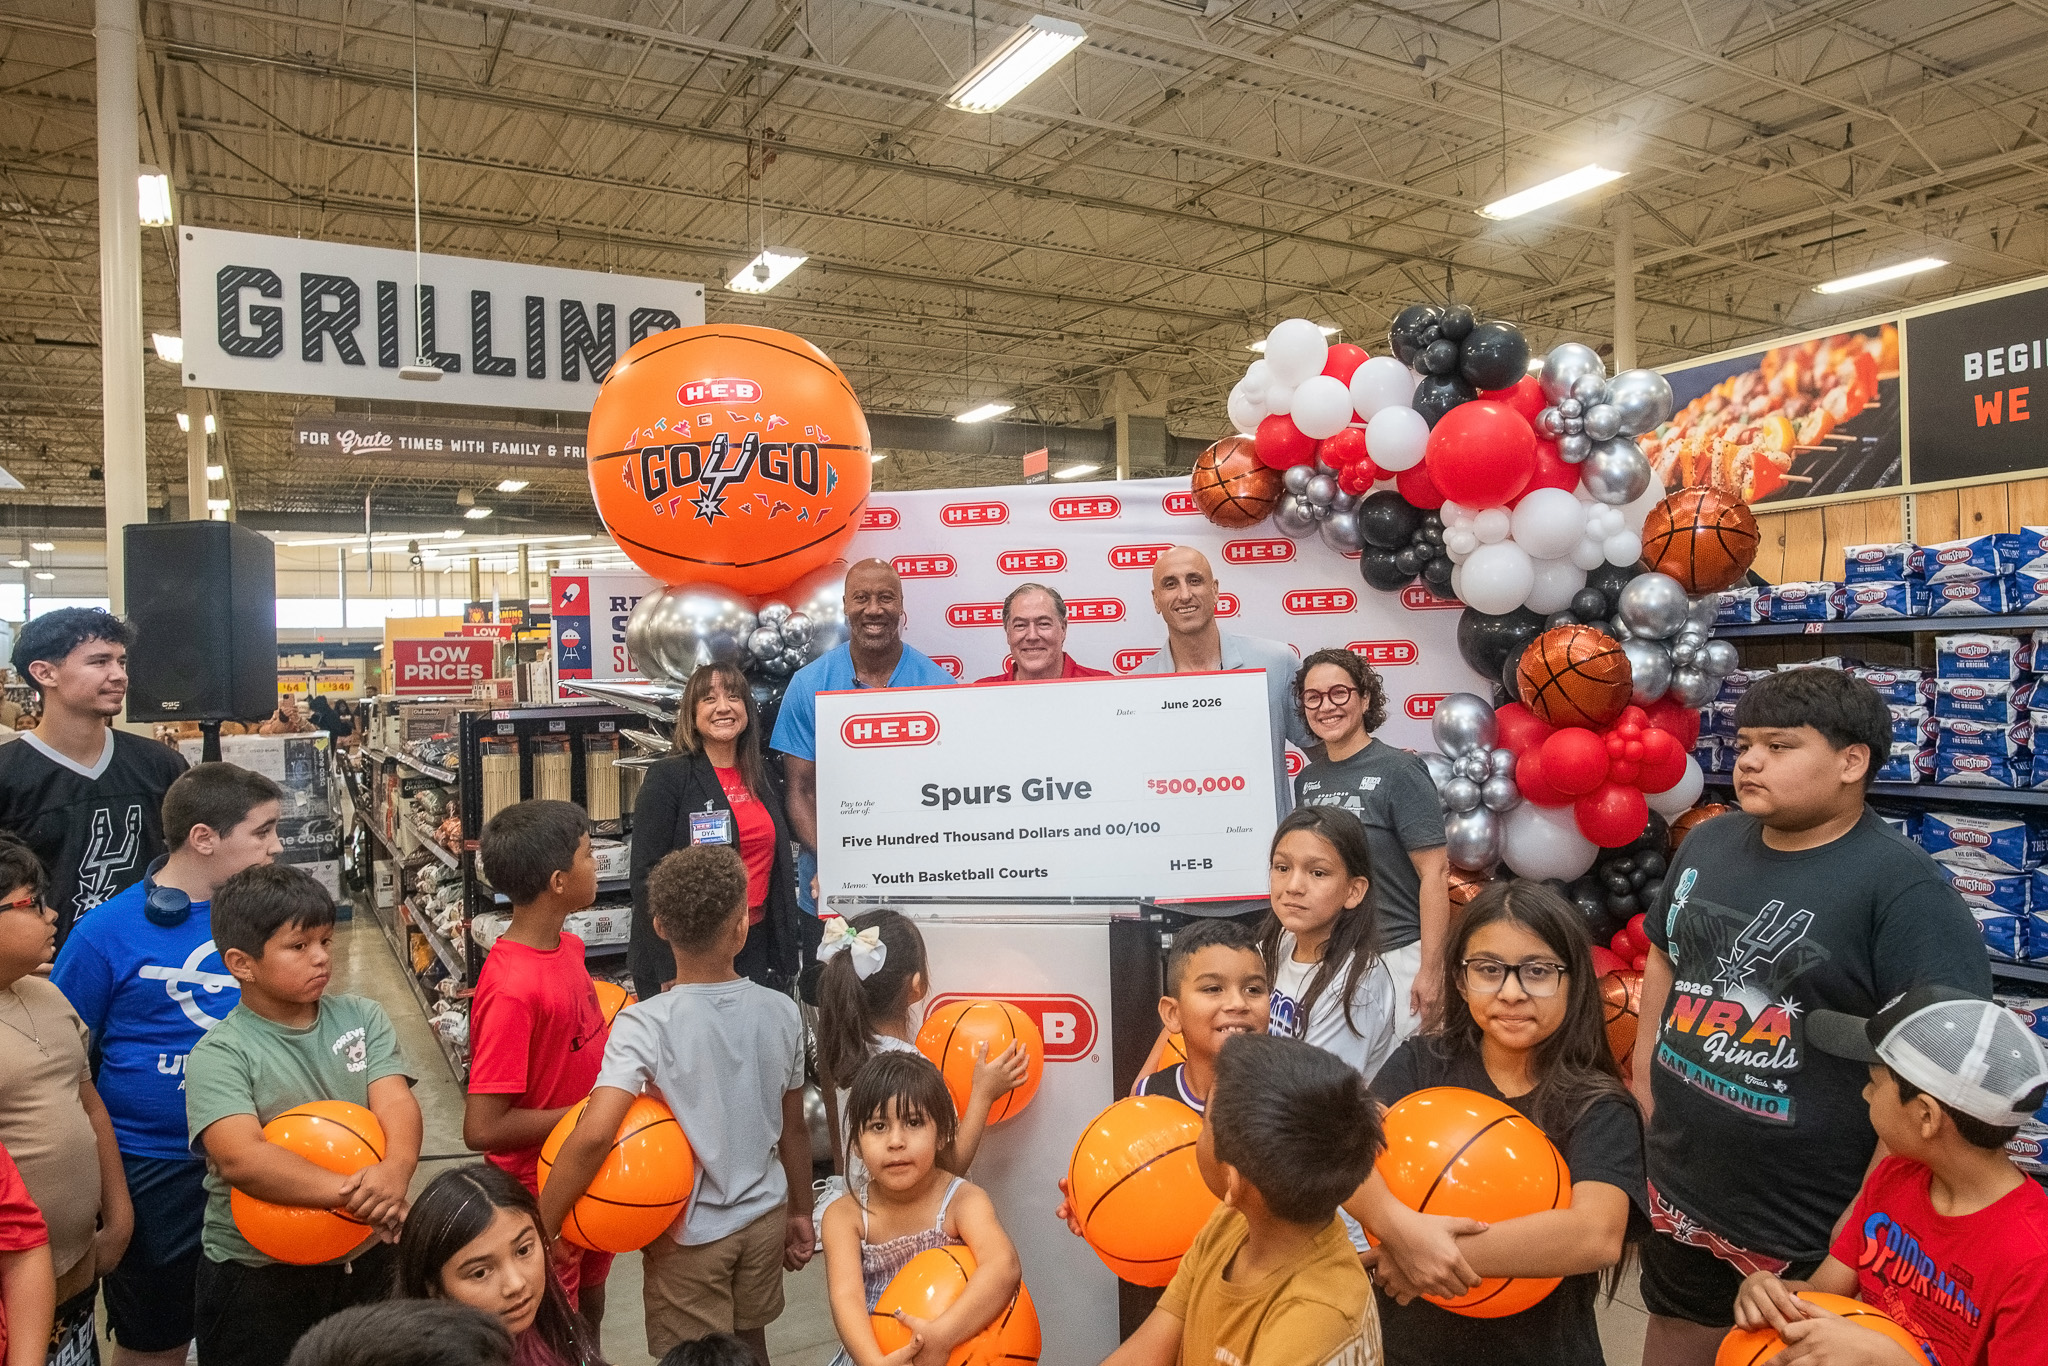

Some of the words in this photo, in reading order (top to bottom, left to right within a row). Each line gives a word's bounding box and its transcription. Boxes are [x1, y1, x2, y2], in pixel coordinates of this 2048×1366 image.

[1963, 338, 2048, 382] BEGI
[686, 383, 754, 402] H-E-B
[1974, 386, 2030, 427] WE
[300, 431, 329, 445] FOR
[337, 429, 393, 454] Grate
[399, 436, 443, 451] TIMES
[450, 439, 485, 453] WITH
[492, 442, 541, 456] FAMILY
[548, 445, 557, 457] &
[641, 443, 701, 502] GO
[759, 442, 819, 497] GO
[948, 506, 1001, 521] H-E-B
[1058, 501, 1112, 515] H-E-B
[1231, 544, 1287, 559] H-E-B
[1938, 550, 1970, 562] KINGSFORD
[897, 560, 949, 573] H-E-B
[1005, 554, 1059, 569] H-E-B
[1857, 590, 1885, 602] KINGSFORD
[1945, 586, 1976, 597] KINGSFORD
[1291, 595, 1348, 609] H-E-B
[1066, 604, 1117, 618] H-E-B
[473, 628, 500, 637] LOW
[1805, 623, 1823, 633] A8
[417, 646, 470, 663] LOW
[1957, 645, 1988, 657] KINGSFORD
[404, 664, 484, 681] PRICES
[1952, 686, 1983, 698] KINGSFORD
[1161, 699, 1189, 710] June
[1192, 698, 1222, 708] 2026
[1960, 703, 1984, 711] ORIGINAL
[853, 720, 928, 740] H-E-B
[1955, 757, 1988, 769] KINGSFORD
[1147, 776, 1246, 795] $500,000
[921, 783, 1012, 811] Spurs
[1021, 776, 1092, 802] Give
[840, 800, 854, 810] Pay
[855, 800, 863, 808] to
[864, 799, 875, 808] the
[840, 807, 860, 816] order
[842, 835, 872, 847] Five
[876, 832, 939, 847] Hundred
[943, 828, 1015, 843] Thousand
[1018, 826, 1070, 840] Dollars
[1074, 825, 1101, 837] and
[1105, 822, 1161, 837] 00/100
[1226, 826, 1253, 834] Dollars
[1952, 832, 1987, 845] KINGSFORD
[1170, 858, 1213, 871] H-E-B
[872, 871, 914, 885] Youth
[918, 868, 995, 883] Basketball
[998, 866, 1049, 879] Courts
[841, 882, 869, 890] Memo:
[1955, 877, 1991, 892] KINGSFORD
[1675, 980, 1713, 996] 2026
[1669, 994, 1791, 1046] NBA
[1703, 1032, 1799, 1069] Finals
[1661, 1049, 1688, 1076] SAN
[1693, 1069, 1779, 1114] ANTONIO
